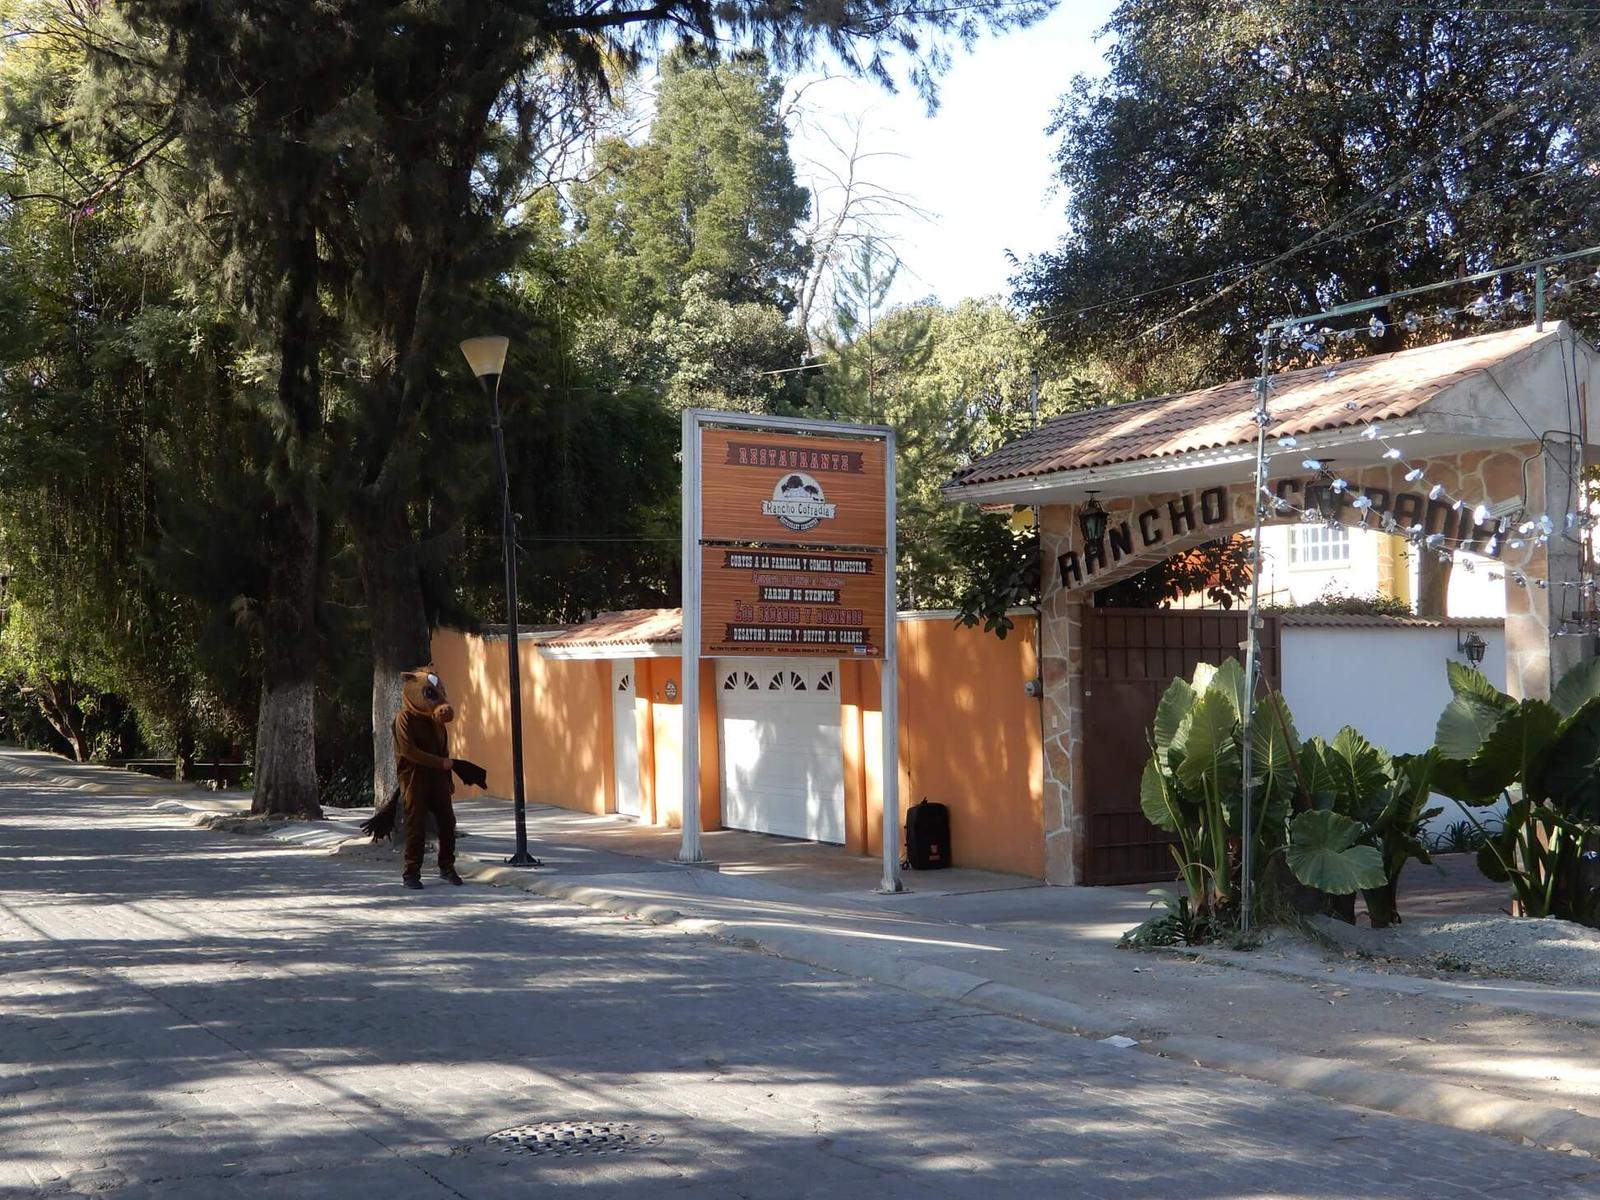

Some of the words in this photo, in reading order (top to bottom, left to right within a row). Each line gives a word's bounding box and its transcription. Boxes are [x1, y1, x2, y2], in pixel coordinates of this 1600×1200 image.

[738, 446, 850, 471] RESTAURANTE
[766, 502, 795, 515] Rancho
[1058, 486, 1226, 590] RANCHO
[730, 555, 753, 569] CORTES
[754, 556, 760, 569] A
[761, 556, 769, 570] LA
[771, 557, 801, 571] PARRILLA
[809, 558, 832, 572] COMIDA
[833, 559, 867, 574] CAMPESTRE
[764, 587, 790, 601] JARDIN
[793, 589, 802, 601] DE
[804, 589, 835, 603] EVENTOS
[804, 608, 812, 625] Y
[733, 628, 766, 641] DESAYUNO
[769, 629, 793, 642] BUFFET
[795, 629, 800, 642] Y
[803, 629, 826, 643] BUFFET
[828, 630, 837, 643] DE
[839, 630, 863, 644] CARNES
